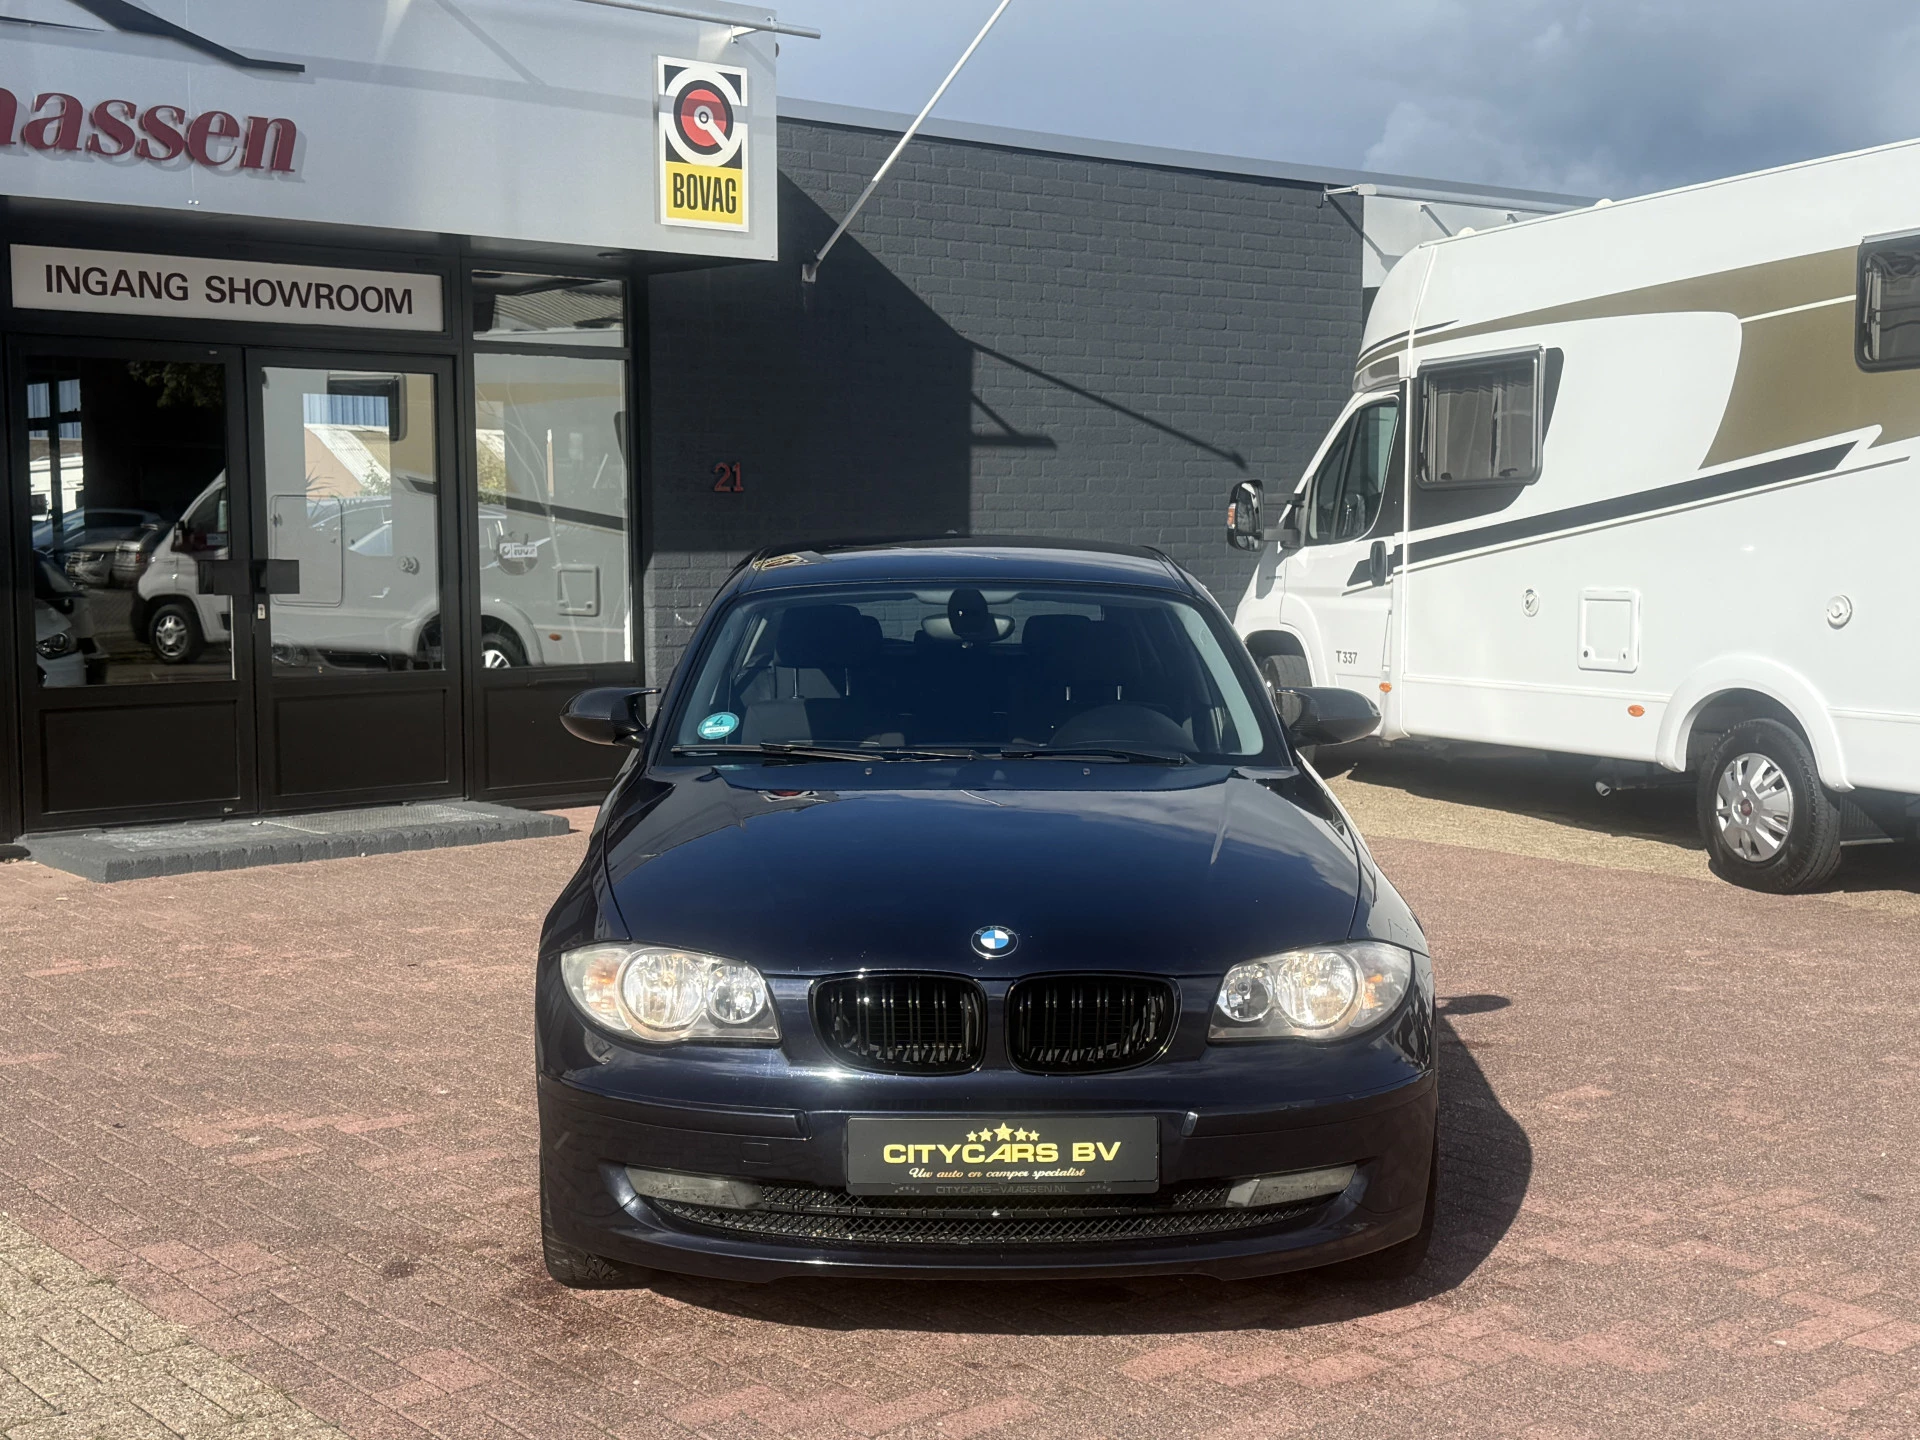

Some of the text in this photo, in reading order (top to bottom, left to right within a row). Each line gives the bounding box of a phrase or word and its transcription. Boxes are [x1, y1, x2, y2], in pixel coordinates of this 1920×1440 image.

[672, 172, 737, 215] BOVAG
[45, 263, 413, 315] INGANG SHOWROOM
[713, 461, 745, 492] 21
[1342, 651, 1358, 665] 337
[883, 1141, 1122, 1164] CITYCARS BV
[908, 1166, 1086, 1180] Uw auto en camper specialist
